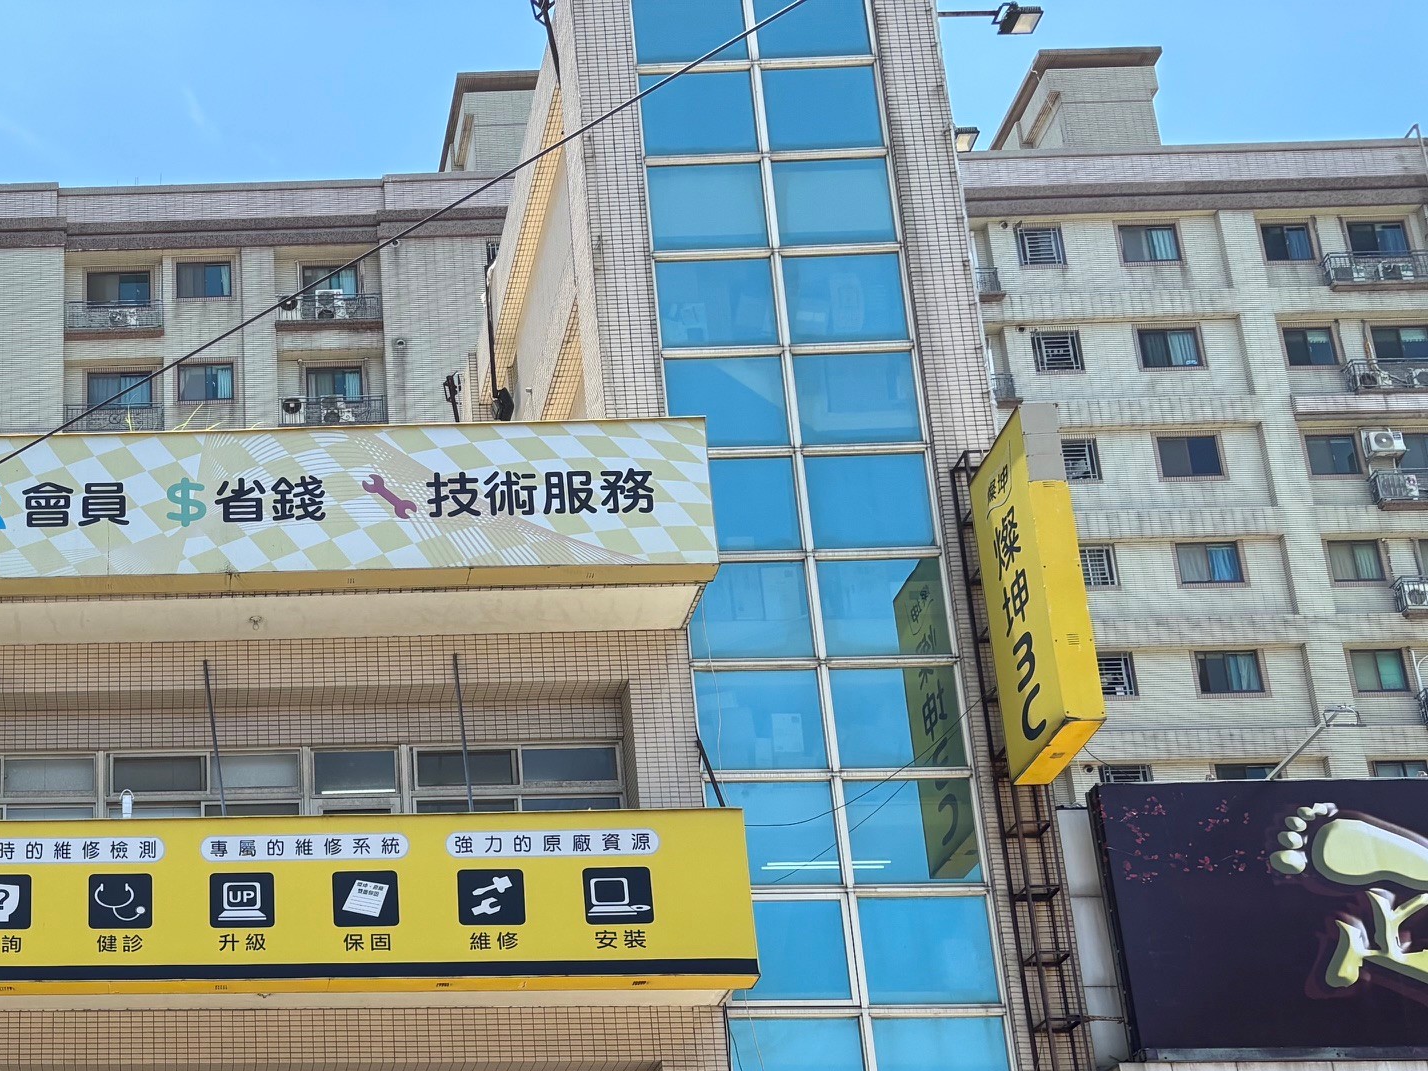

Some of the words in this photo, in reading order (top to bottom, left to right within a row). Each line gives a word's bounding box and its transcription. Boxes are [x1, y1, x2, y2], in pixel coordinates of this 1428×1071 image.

[21, 482, 130, 528] 會員
[215, 475, 328, 523] 省錢
[427, 468, 657, 517] 技術服務
[993, 507, 1047, 741] 燦坤3C
[210, 837, 400, 857] 專屬的維修系統
[454, 833, 651, 854] 強力的原廠資源
[228, 890, 255, 903] UP
[96, 934, 143, 953] 健診
[218, 933, 266, 951] 升級
[343, 933, 391, 951] 保固
[469, 931, 519, 950] 維修
[594, 929, 647, 949] 安裝
